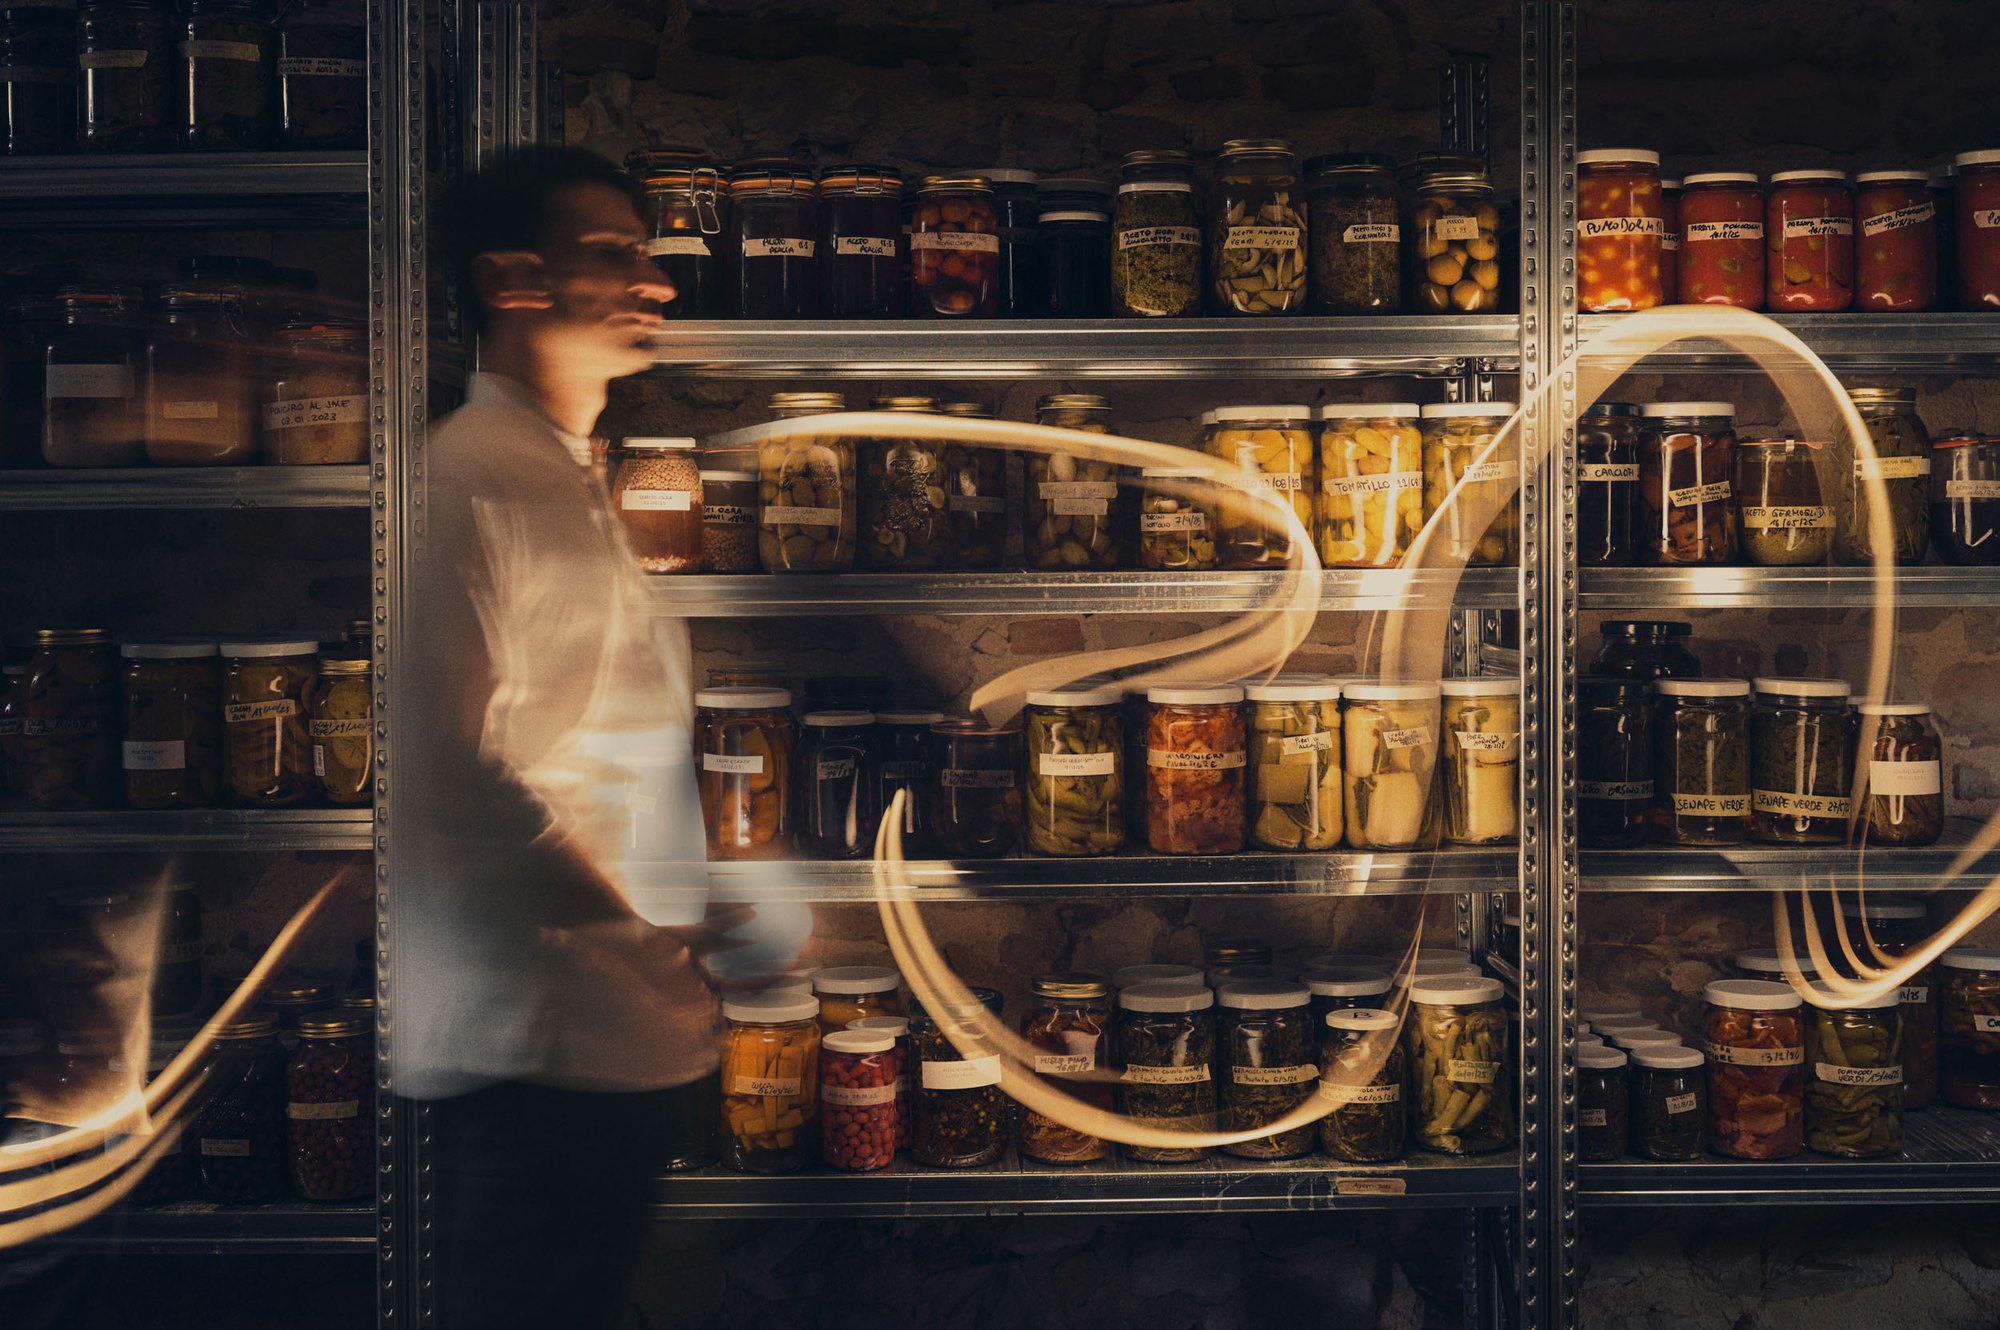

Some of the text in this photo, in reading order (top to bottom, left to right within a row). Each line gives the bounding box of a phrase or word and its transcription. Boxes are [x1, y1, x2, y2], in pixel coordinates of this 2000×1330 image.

[1676, 799, 1745, 811] SENAPE VERDE
[1756, 795, 1789, 809] SENAPE
[1793, 799, 1823, 811] VERDE
